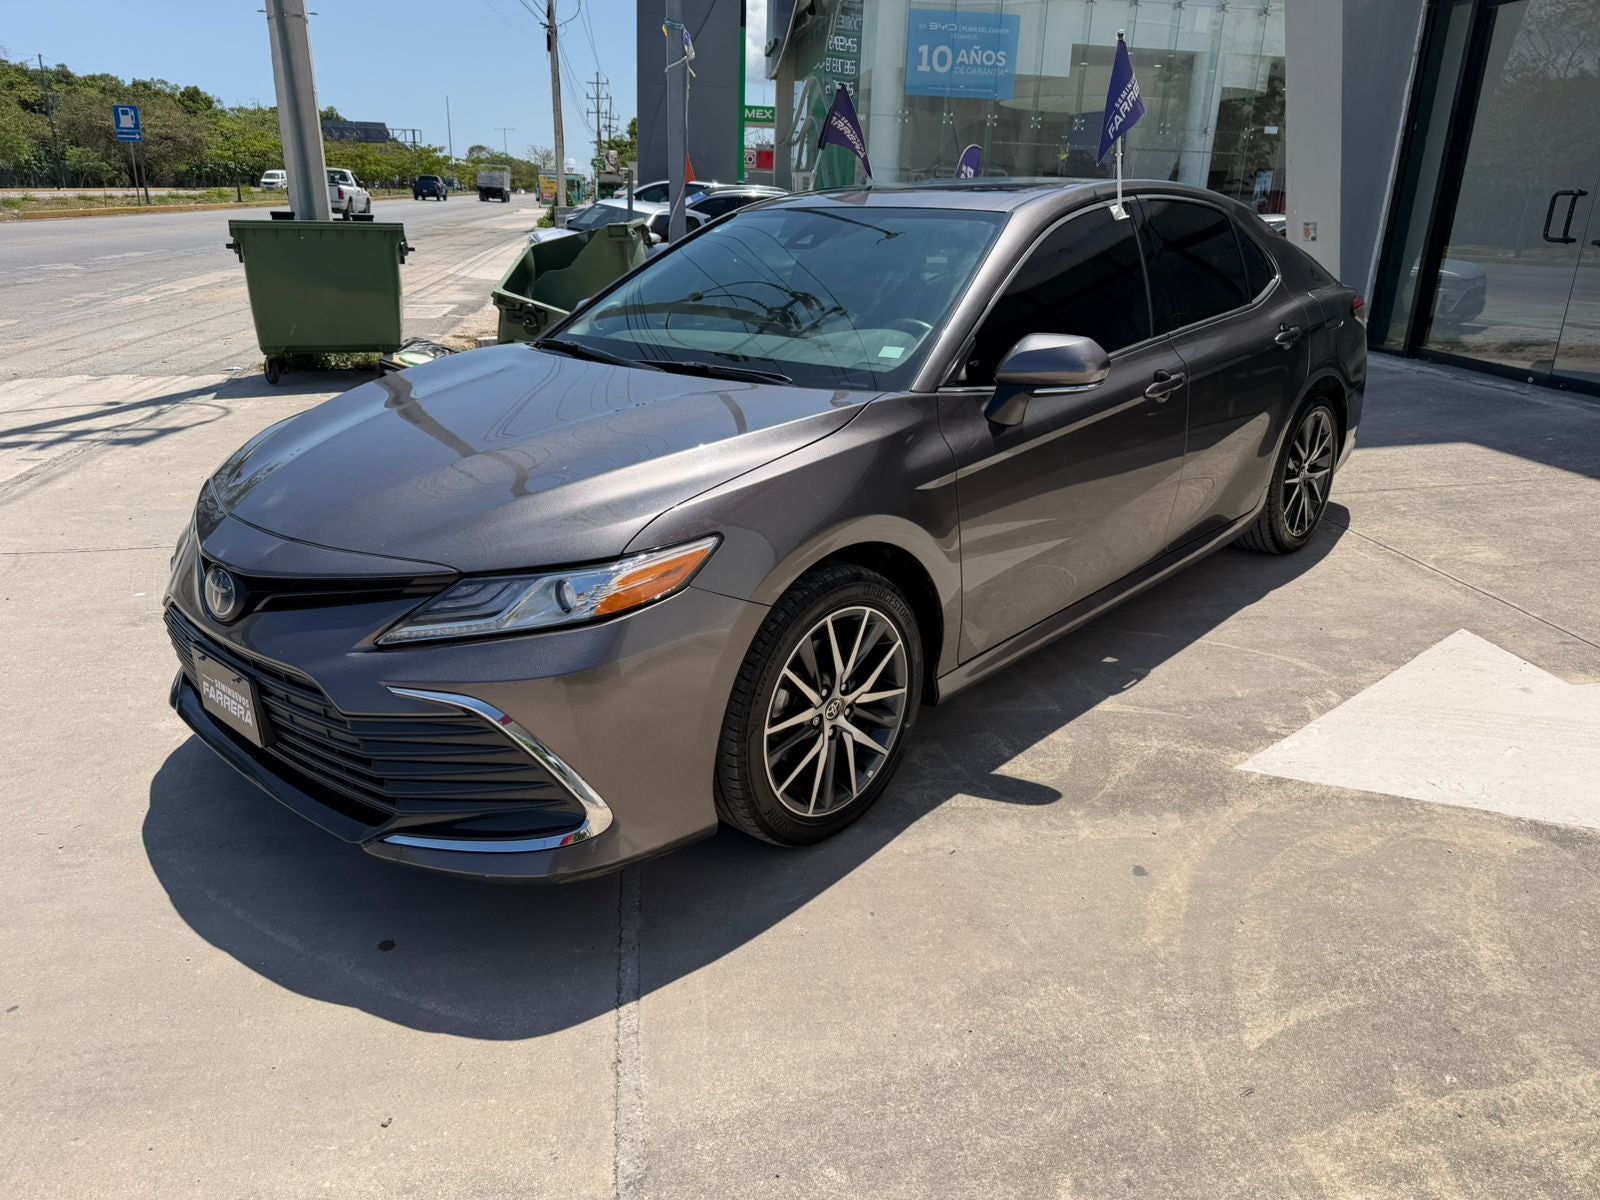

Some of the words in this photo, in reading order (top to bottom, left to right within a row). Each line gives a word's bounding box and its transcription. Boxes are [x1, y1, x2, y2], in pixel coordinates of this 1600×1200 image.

[928, 22, 957, 31] BYD
[916, 44, 953, 73] 10
[956, 45, 1007, 67] AÑOS
[954, 66, 965, 75] DE
[202, 680, 253, 727] FARRERA
[214, 679, 249, 708] SEMINUEVOS
